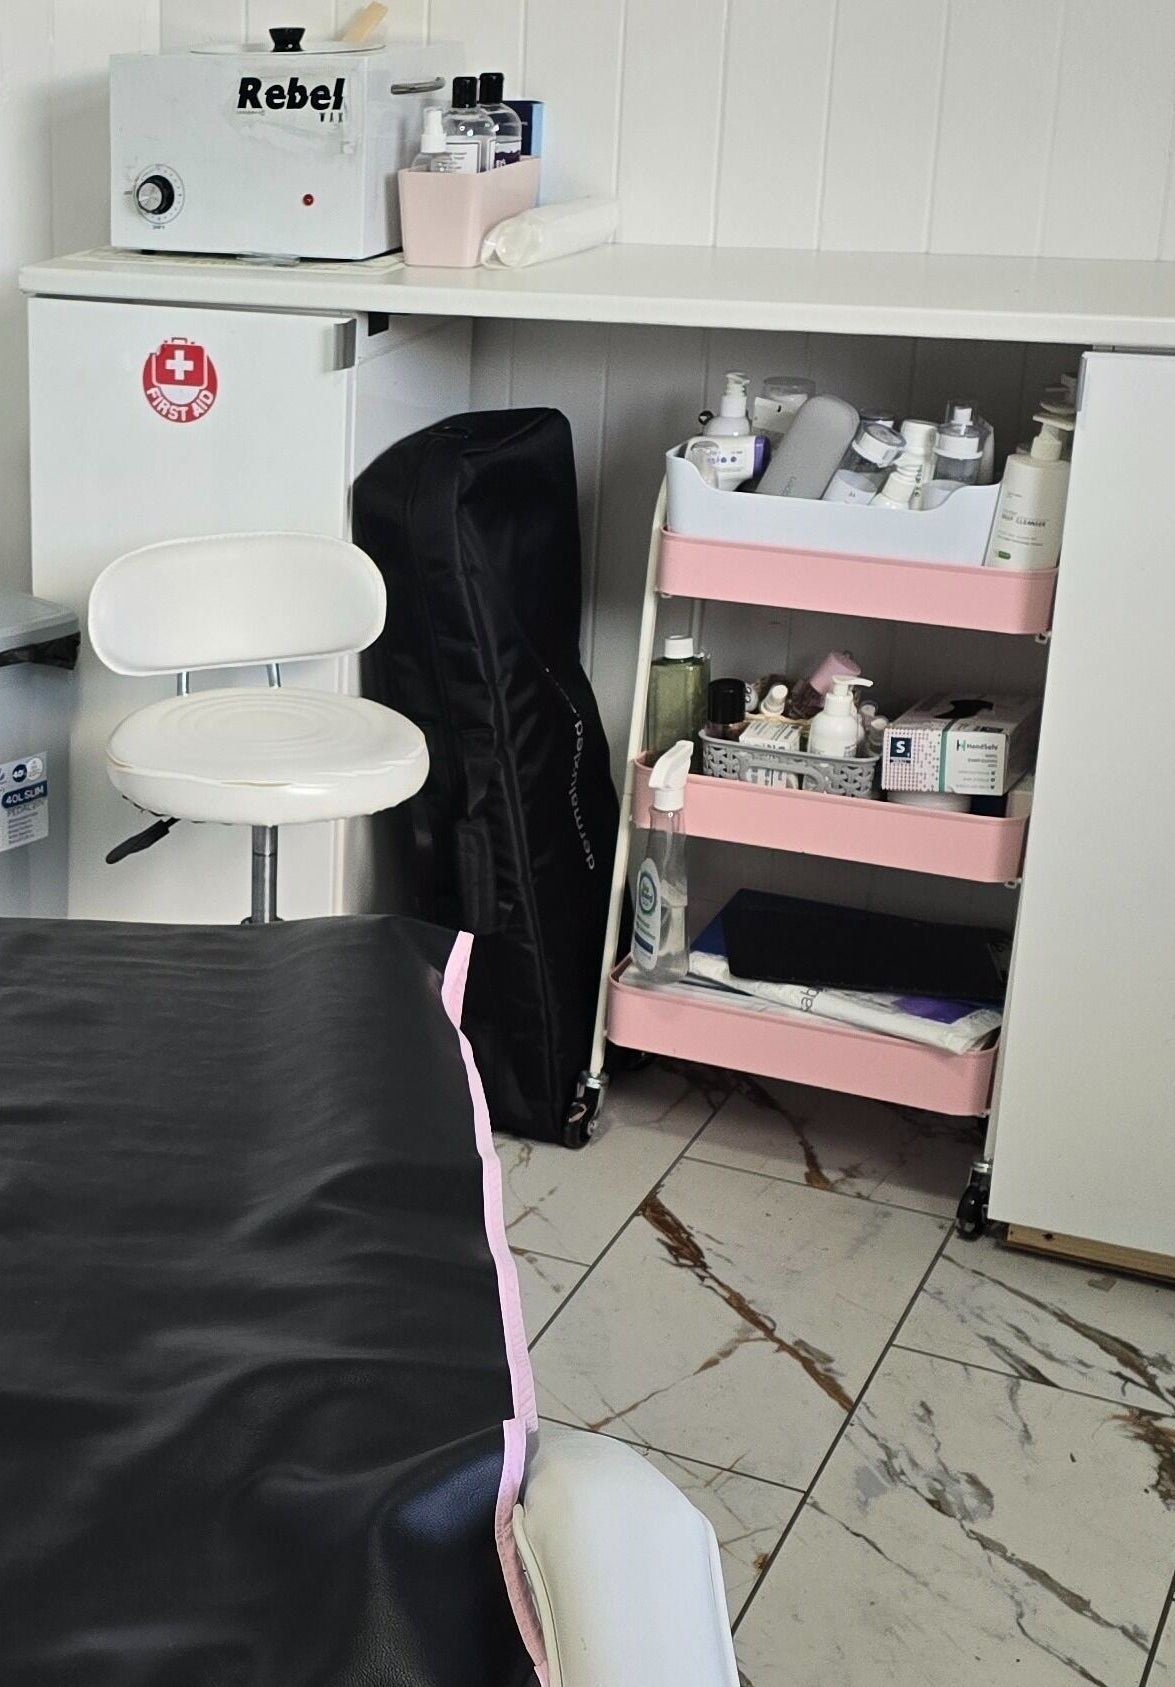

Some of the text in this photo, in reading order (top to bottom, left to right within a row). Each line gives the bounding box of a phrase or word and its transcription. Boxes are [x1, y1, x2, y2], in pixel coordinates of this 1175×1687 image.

[236, 76, 346, 111] Rebel
[146, 386, 214, 422] FIRST AID
